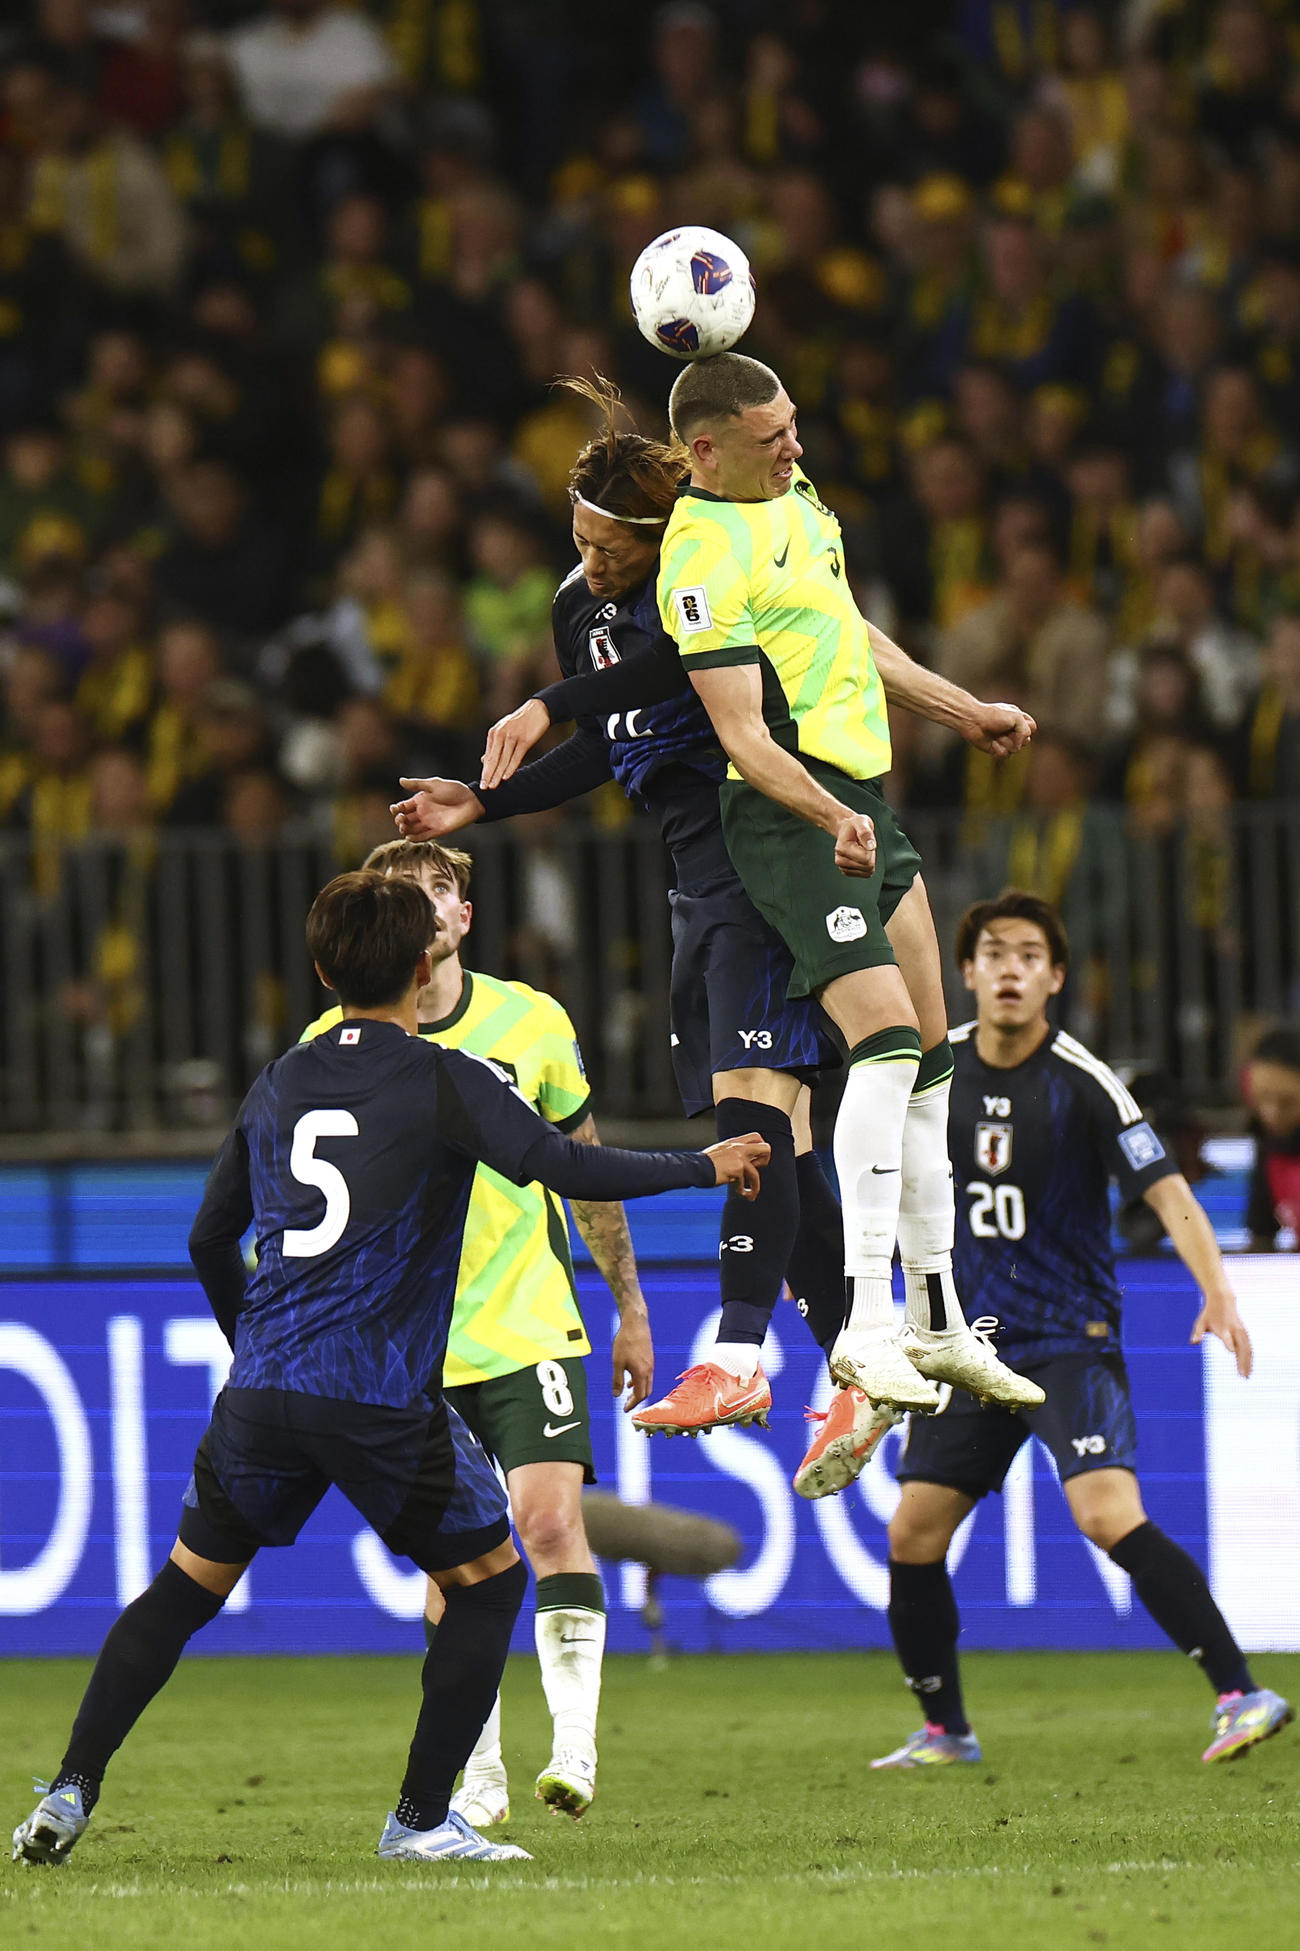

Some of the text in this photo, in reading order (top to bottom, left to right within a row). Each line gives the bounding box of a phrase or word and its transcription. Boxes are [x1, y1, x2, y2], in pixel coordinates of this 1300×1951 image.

[737, 1030, 773, 1050] Y-3
[282, 1108, 360, 1258] 5
[966, 1180, 1026, 1242] 20
[535, 1360, 576, 1417] 8
